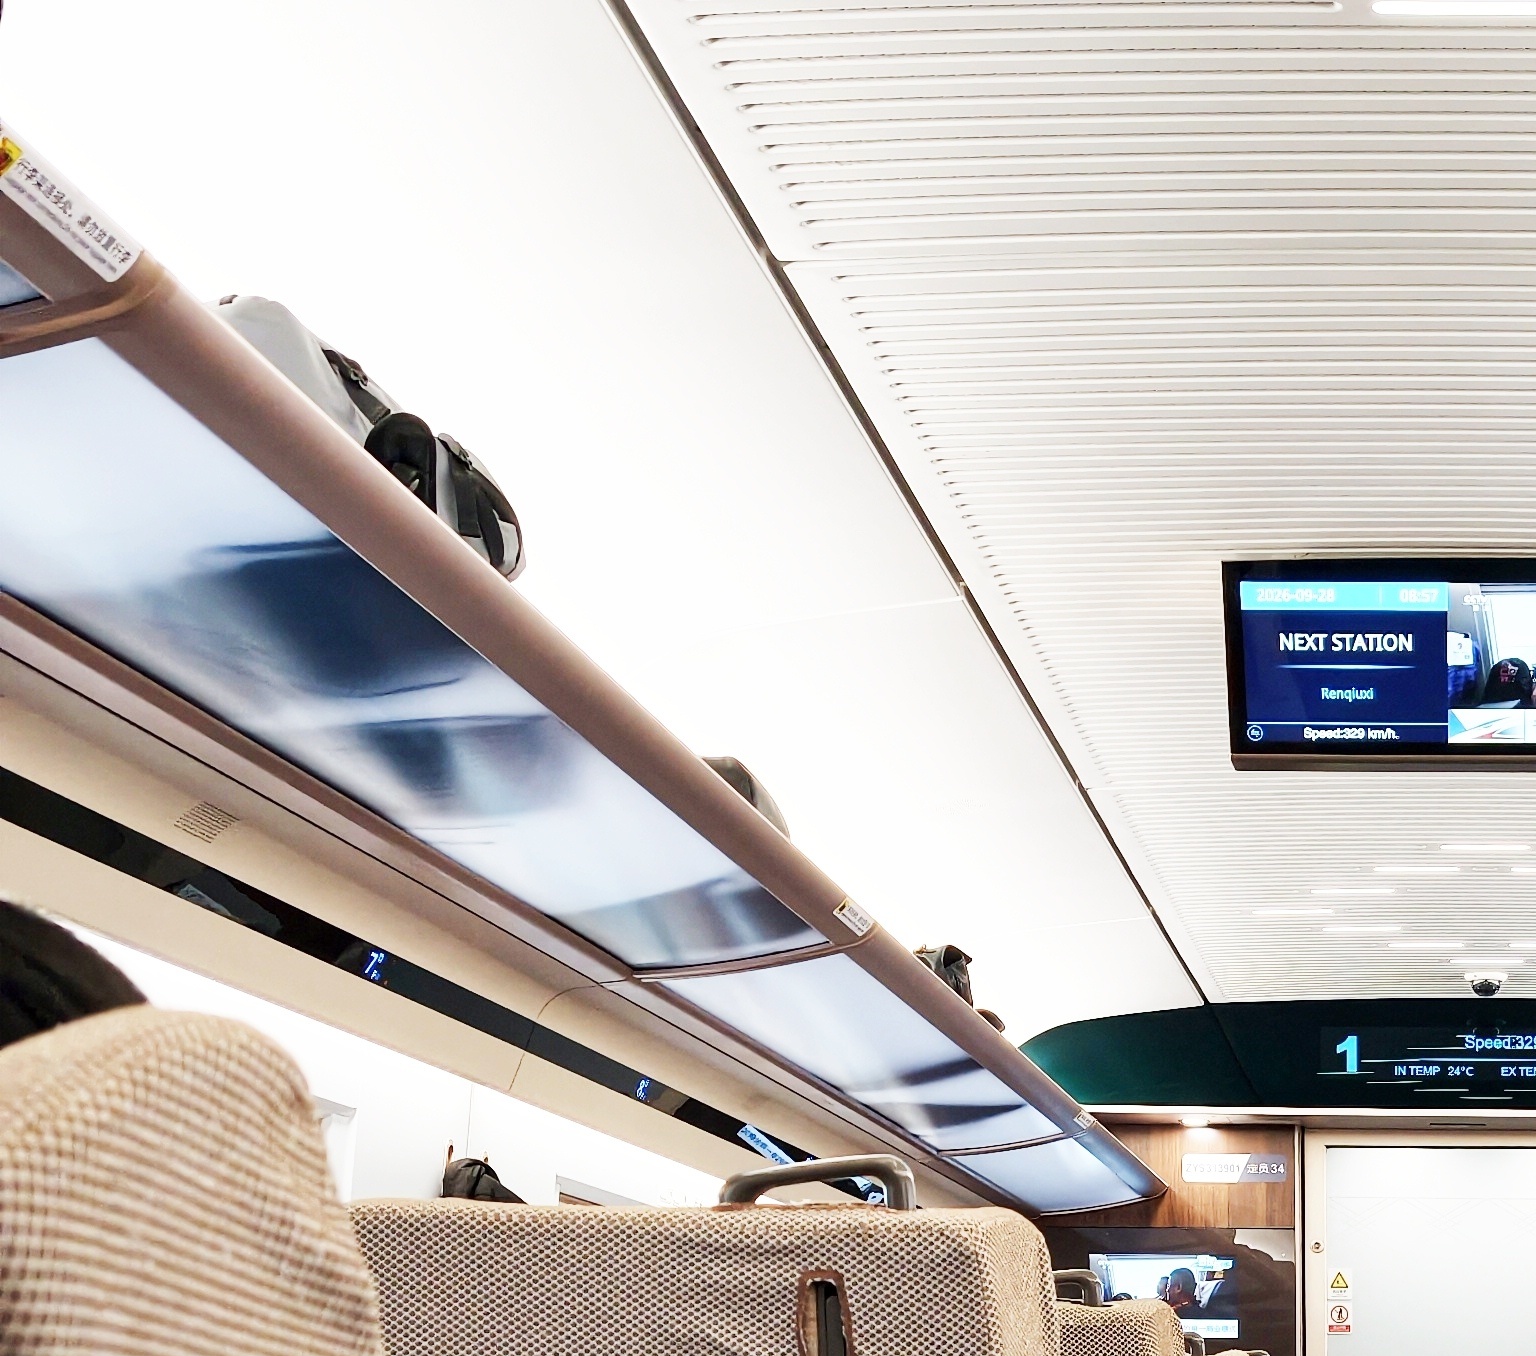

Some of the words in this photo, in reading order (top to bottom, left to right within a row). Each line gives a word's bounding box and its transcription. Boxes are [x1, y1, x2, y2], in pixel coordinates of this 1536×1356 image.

[1400, 588, 1439, 603] 08:57
[1279, 632, 1328, 652] NEXT
[1331, 633, 1413, 652] STATION
[1321, 687, 1374, 702] Renqiuxi
[1303, 727, 1365, 741] Speed:329
[365, 952, 378, 973] 7
[1336, 1035, 1358, 1074] 1
[1394, 1065, 1407, 1076] IN
[1409, 1065, 1441, 1076] TEMP
[1500, 1066, 1516, 1077] EX
